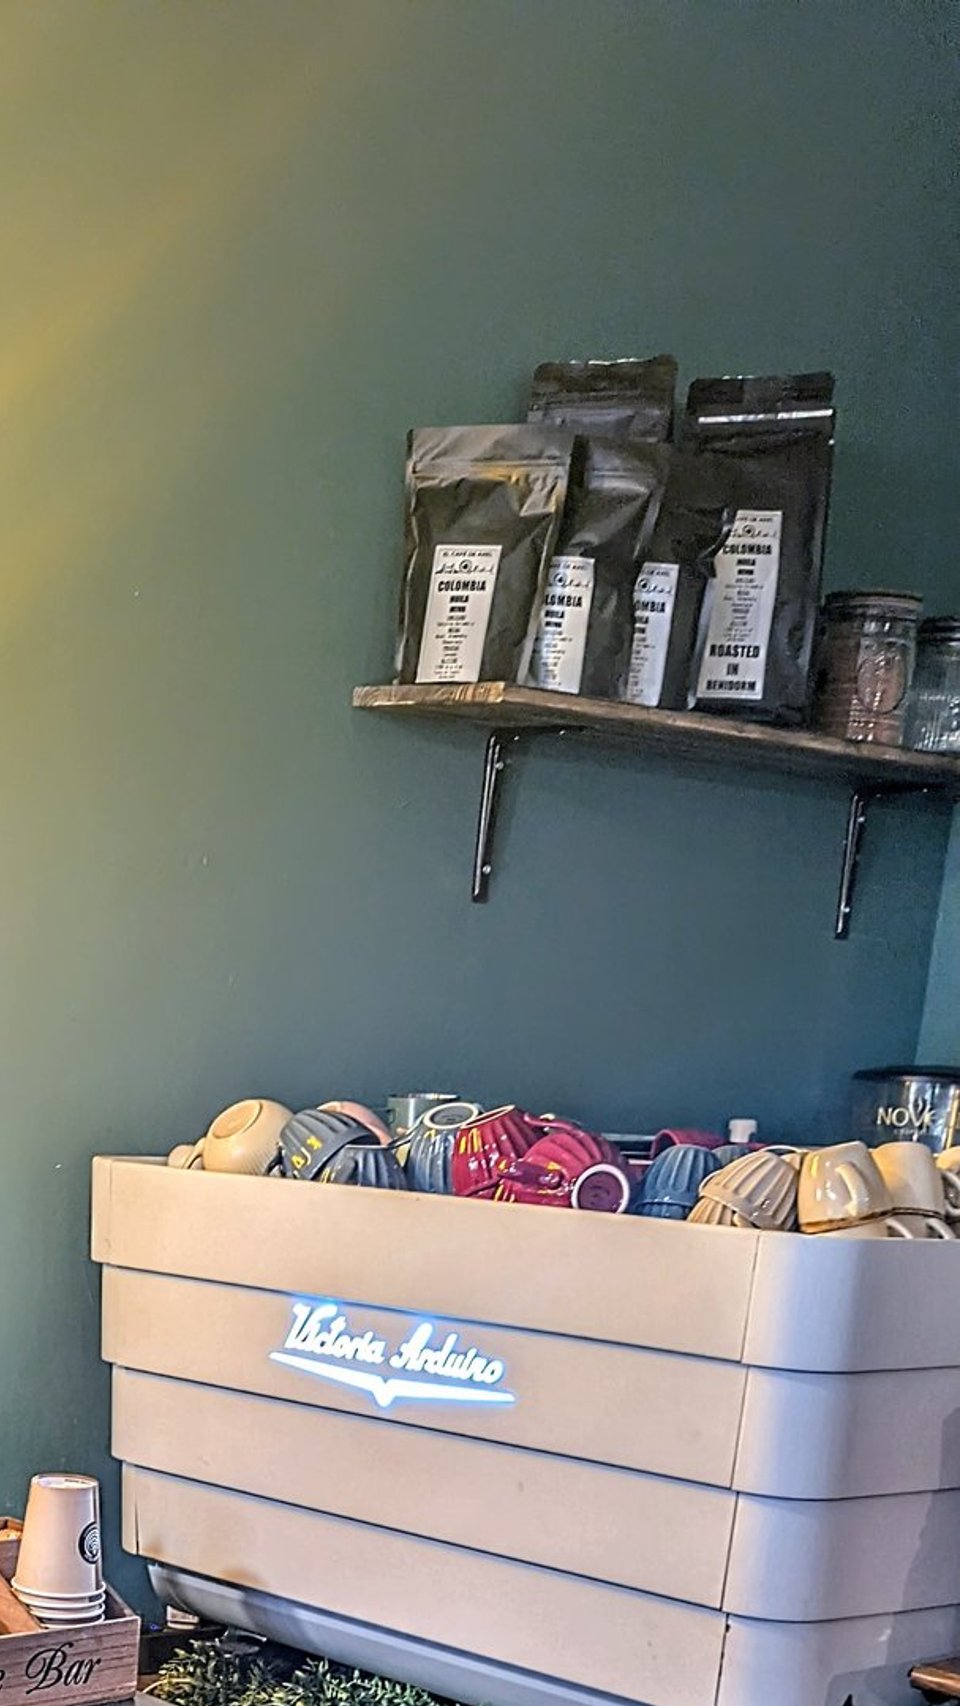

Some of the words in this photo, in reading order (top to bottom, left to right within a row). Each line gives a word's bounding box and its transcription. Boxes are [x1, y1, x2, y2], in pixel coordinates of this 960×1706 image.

[722, 543, 773, 556] COLOMBIA
[437, 580, 487, 593] COLOMBIA
[544, 593, 583, 609] LOMBIA
[709, 643, 760, 659] ROASTED
[726, 662, 739, 676] IN
[706, 680, 757, 692] BENIDORM
[284, 1302, 387, 1365] Victoria
[389, 1322, 504, 1385] Arduino
[24, 1641, 102, 1695] Bar
